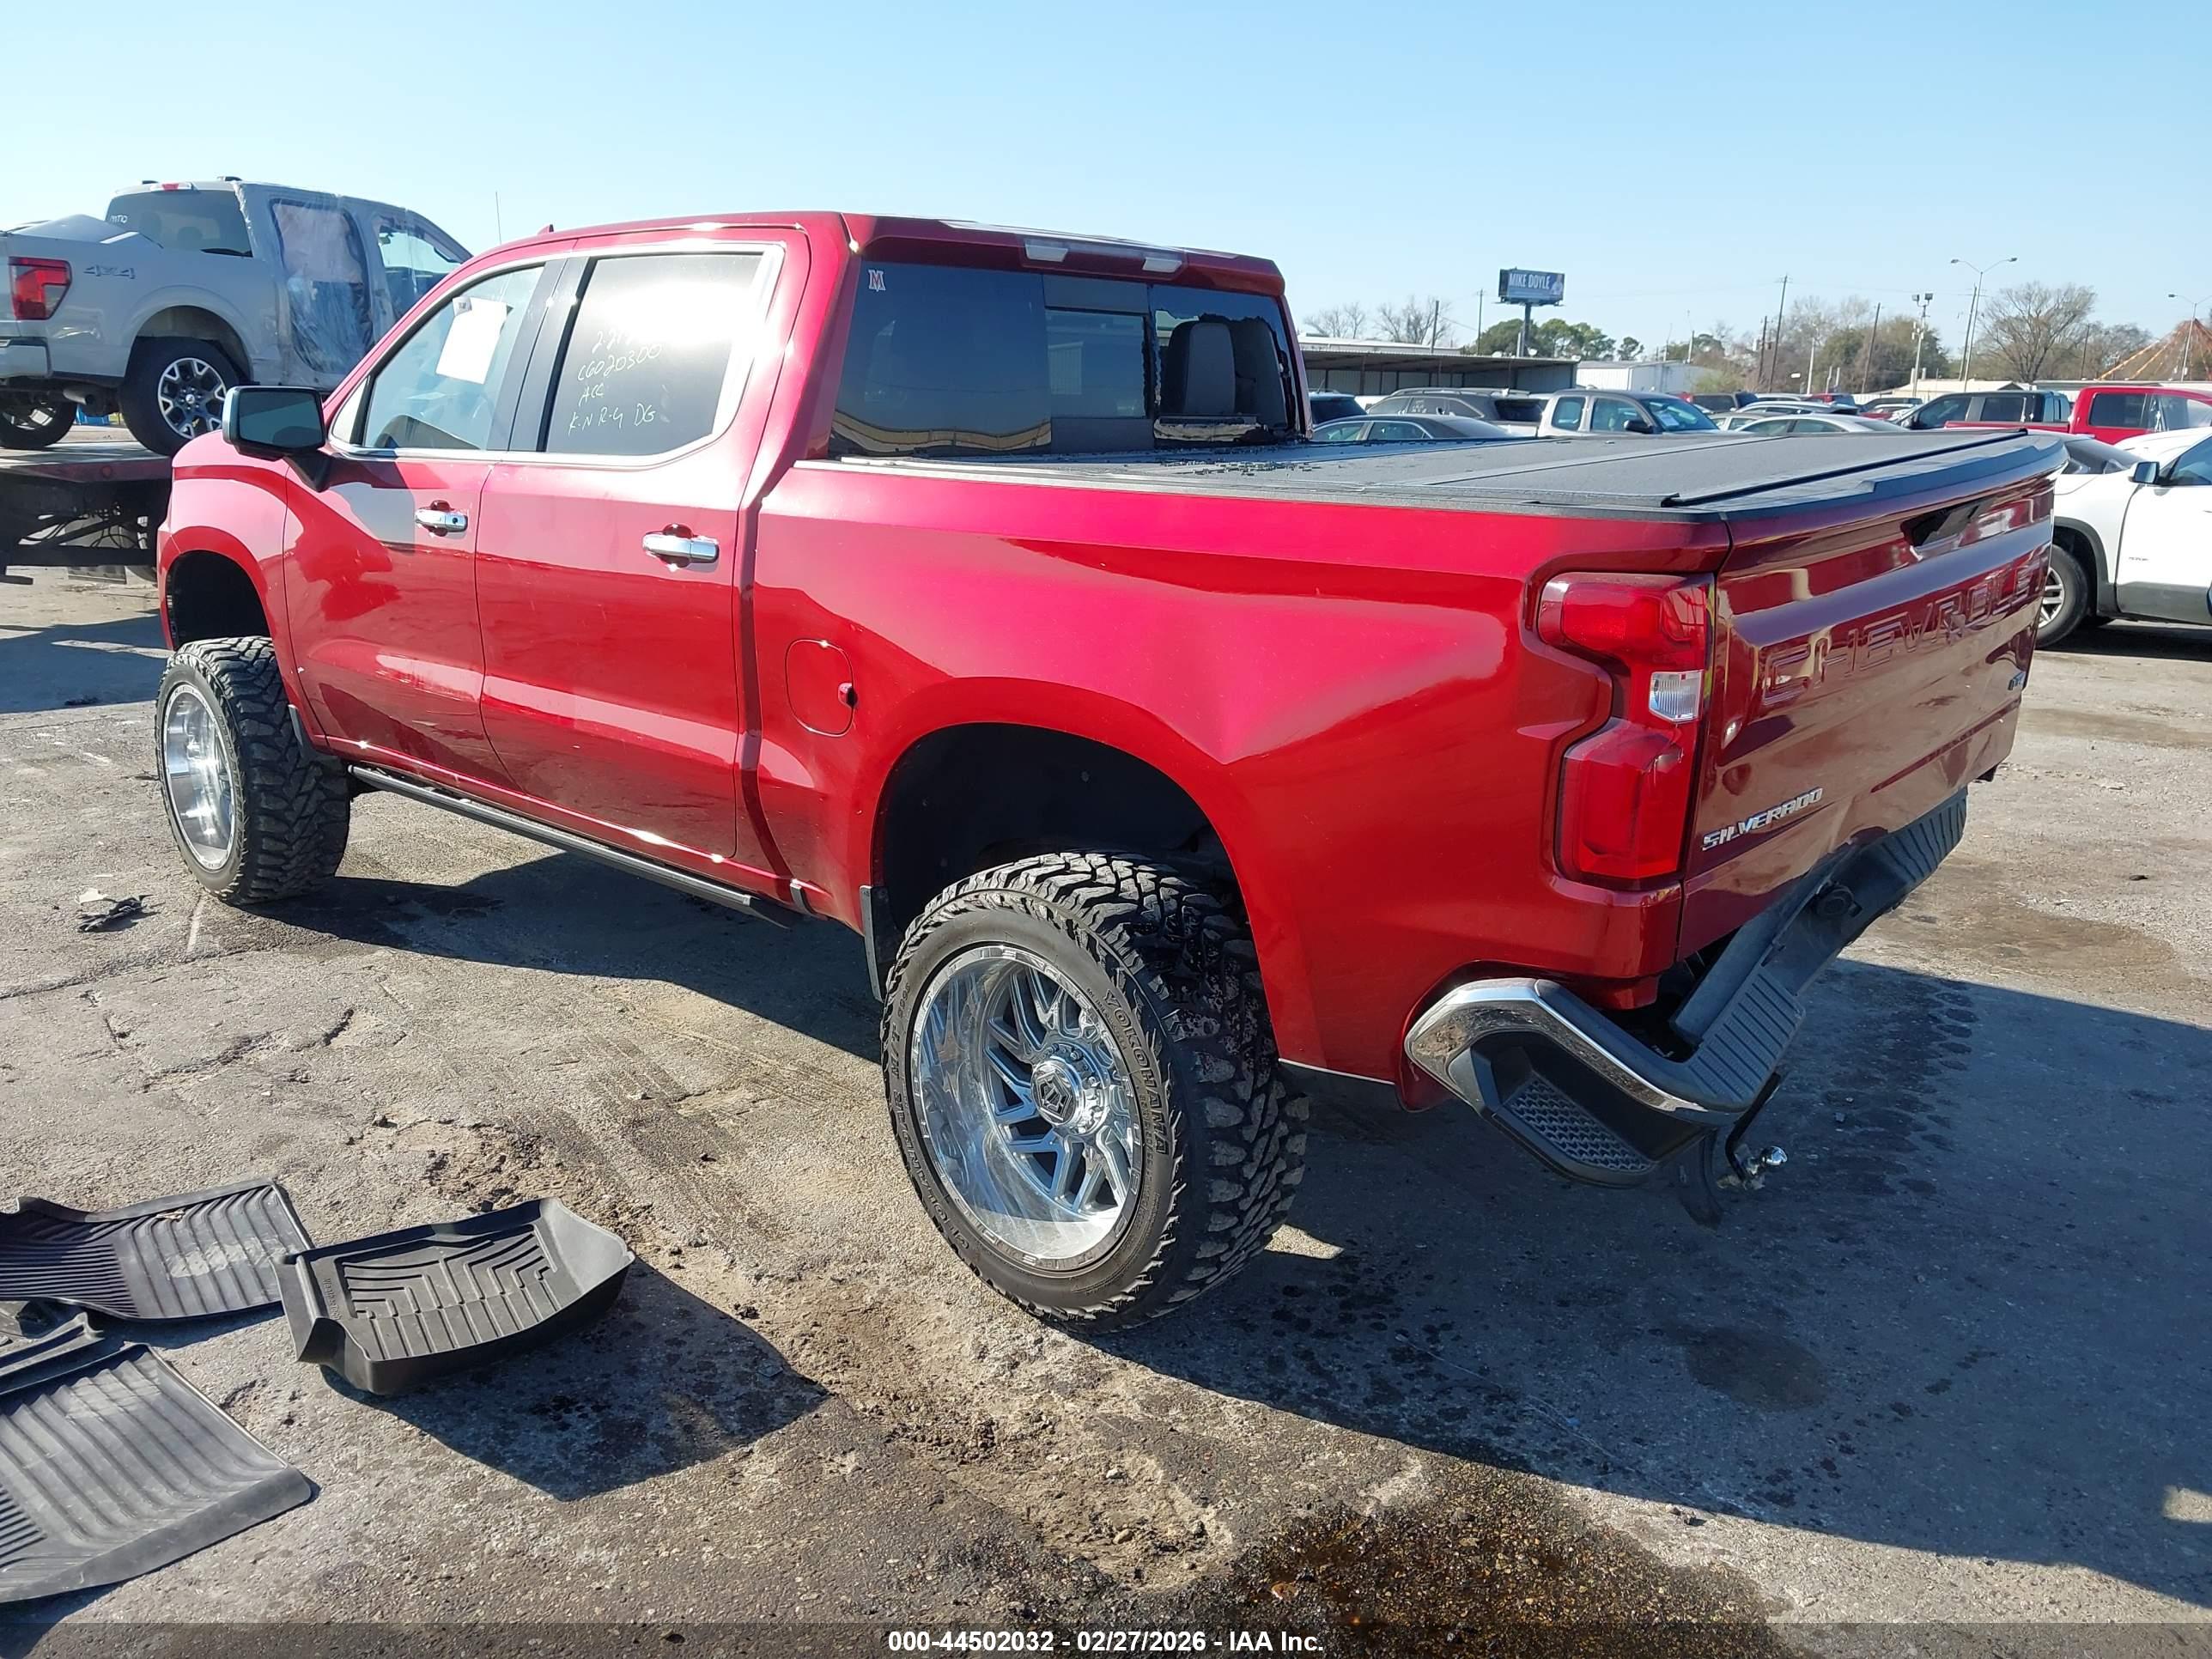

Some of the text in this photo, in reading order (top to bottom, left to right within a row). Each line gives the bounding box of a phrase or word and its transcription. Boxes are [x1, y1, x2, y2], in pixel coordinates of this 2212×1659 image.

[1509, 274, 1552, 289] MIKE DOYLE
[1702, 787, 1824, 851] SILVERADO
[1104, 988, 1169, 1155] YOKOHAMA
